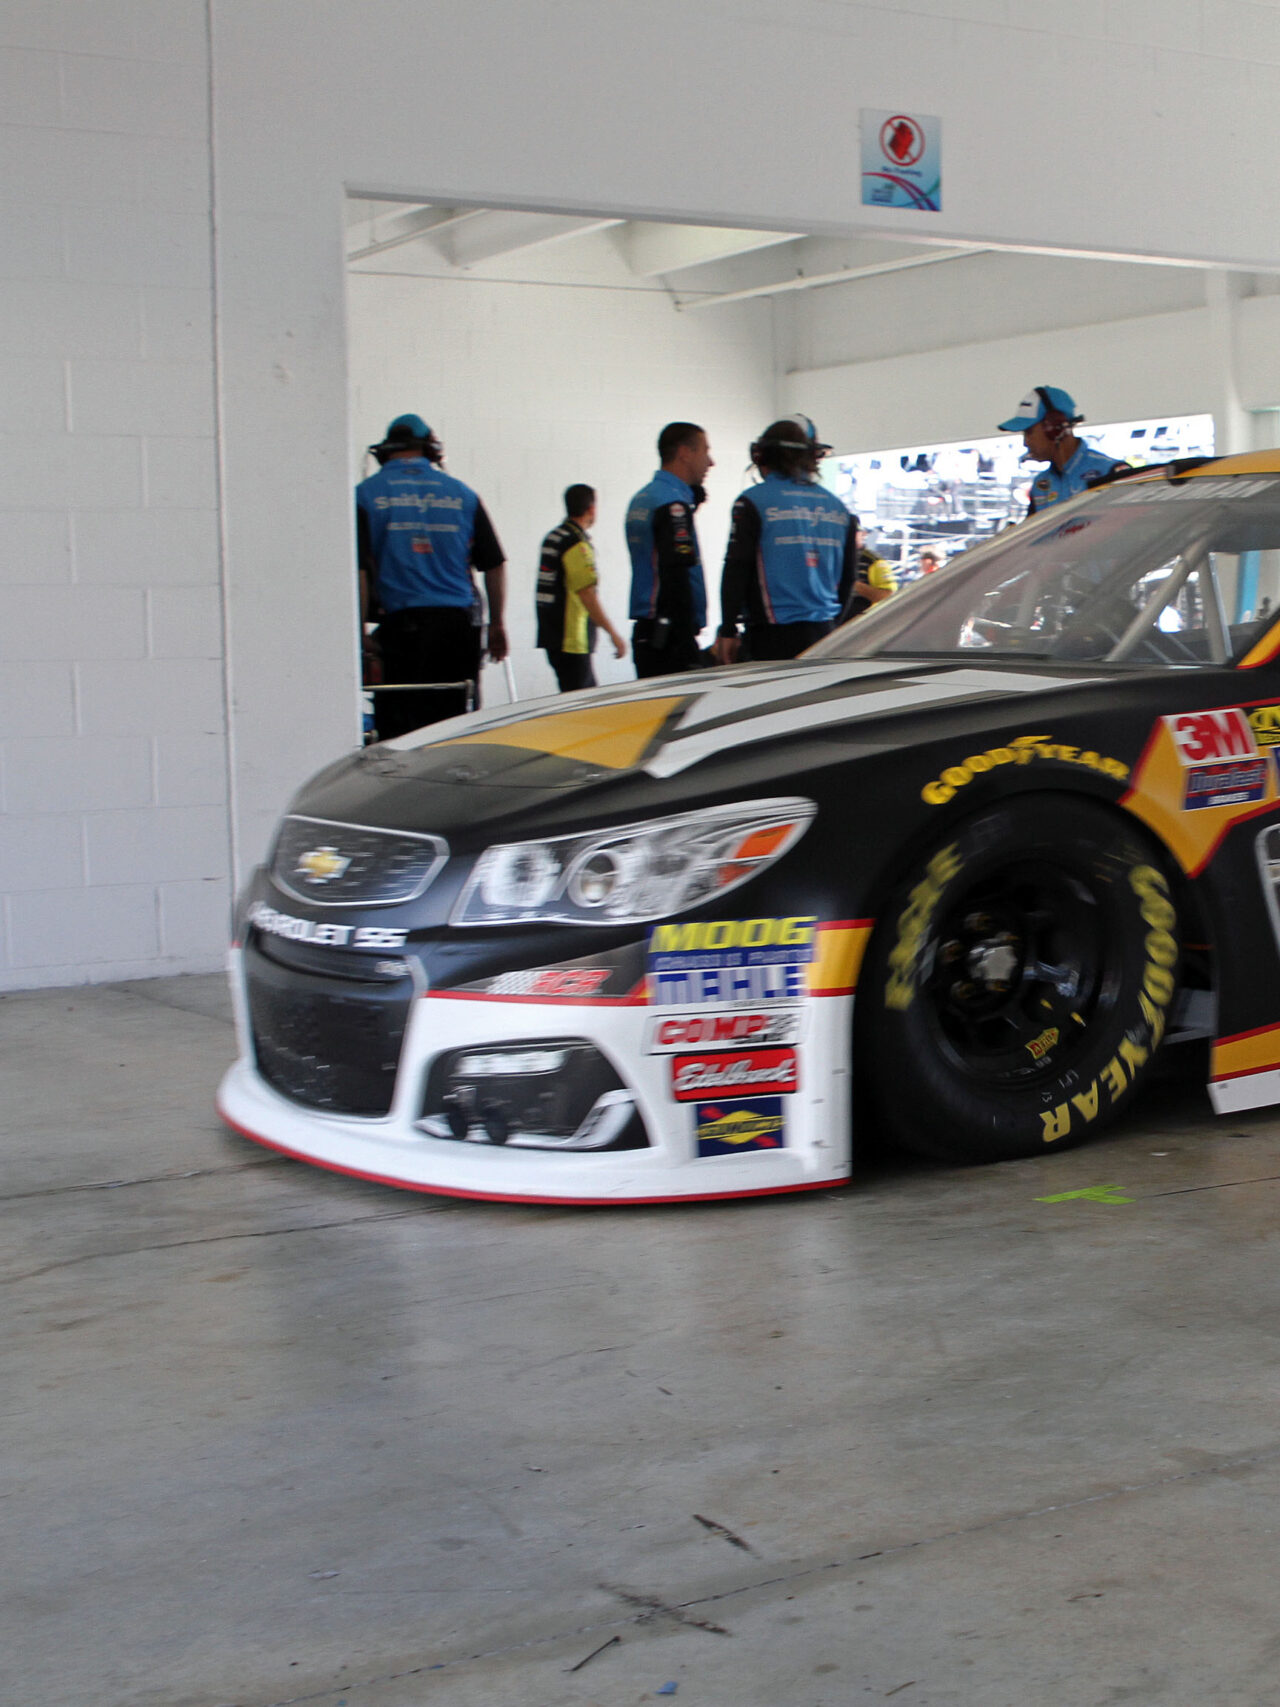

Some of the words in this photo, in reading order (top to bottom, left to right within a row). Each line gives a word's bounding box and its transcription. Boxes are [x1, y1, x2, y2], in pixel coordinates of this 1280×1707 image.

[1175, 712, 1255, 761] 3M
[921, 735, 1130, 805] GOODYEAR
[648, 916, 818, 953] MOOG
